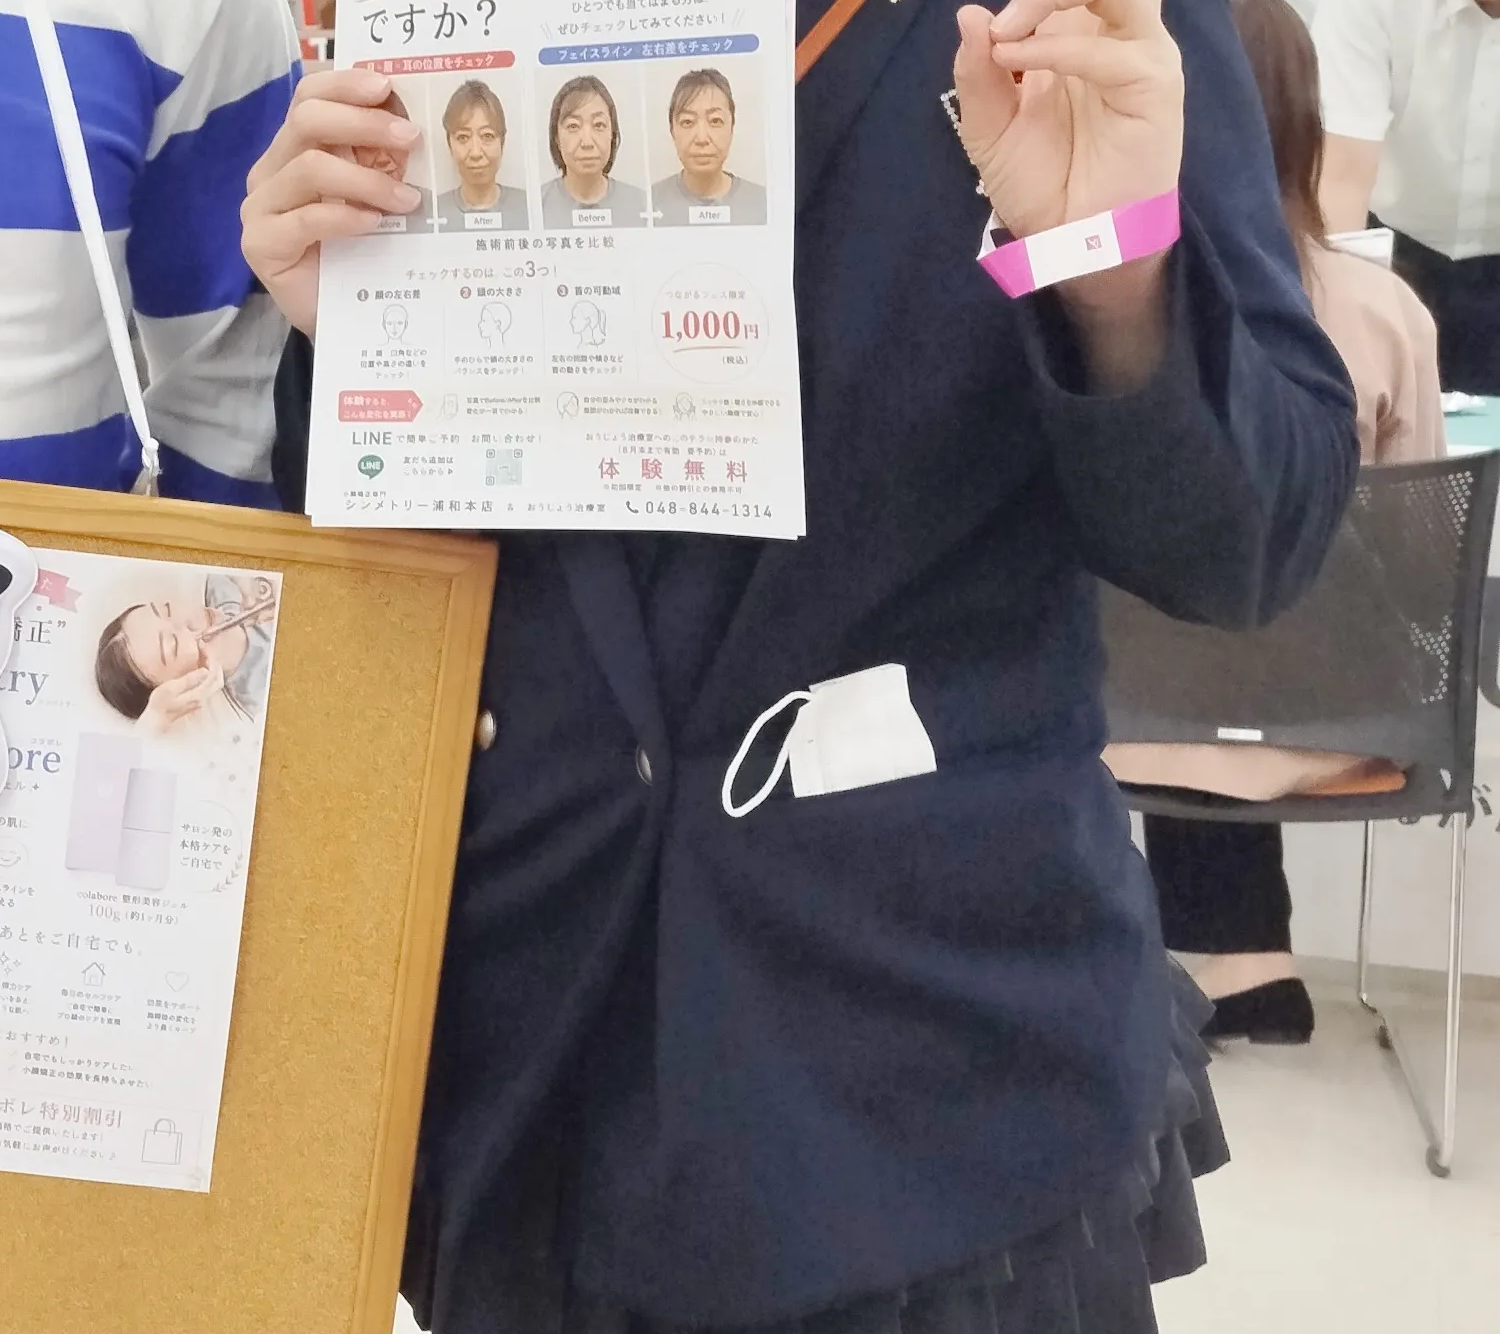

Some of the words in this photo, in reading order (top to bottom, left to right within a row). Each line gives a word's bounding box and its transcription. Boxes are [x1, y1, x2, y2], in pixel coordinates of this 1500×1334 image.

[578, 213, 606, 223] Before
[698, 210, 721, 220] After
[476, 236, 616, 252] 施術前後の写真を比較
[660, 309, 760, 343] 1,000円
[598, 456, 749, 484] 体験無料
[344, 498, 494, 514] シンメトリー浦和本店
[644, 500, 774, 519] 048-844-1314
[181, 823, 233, 839] サロン発の
[179, 838, 231, 856] 本格ケアを
[180, 856, 224, 872] ご自宅で
